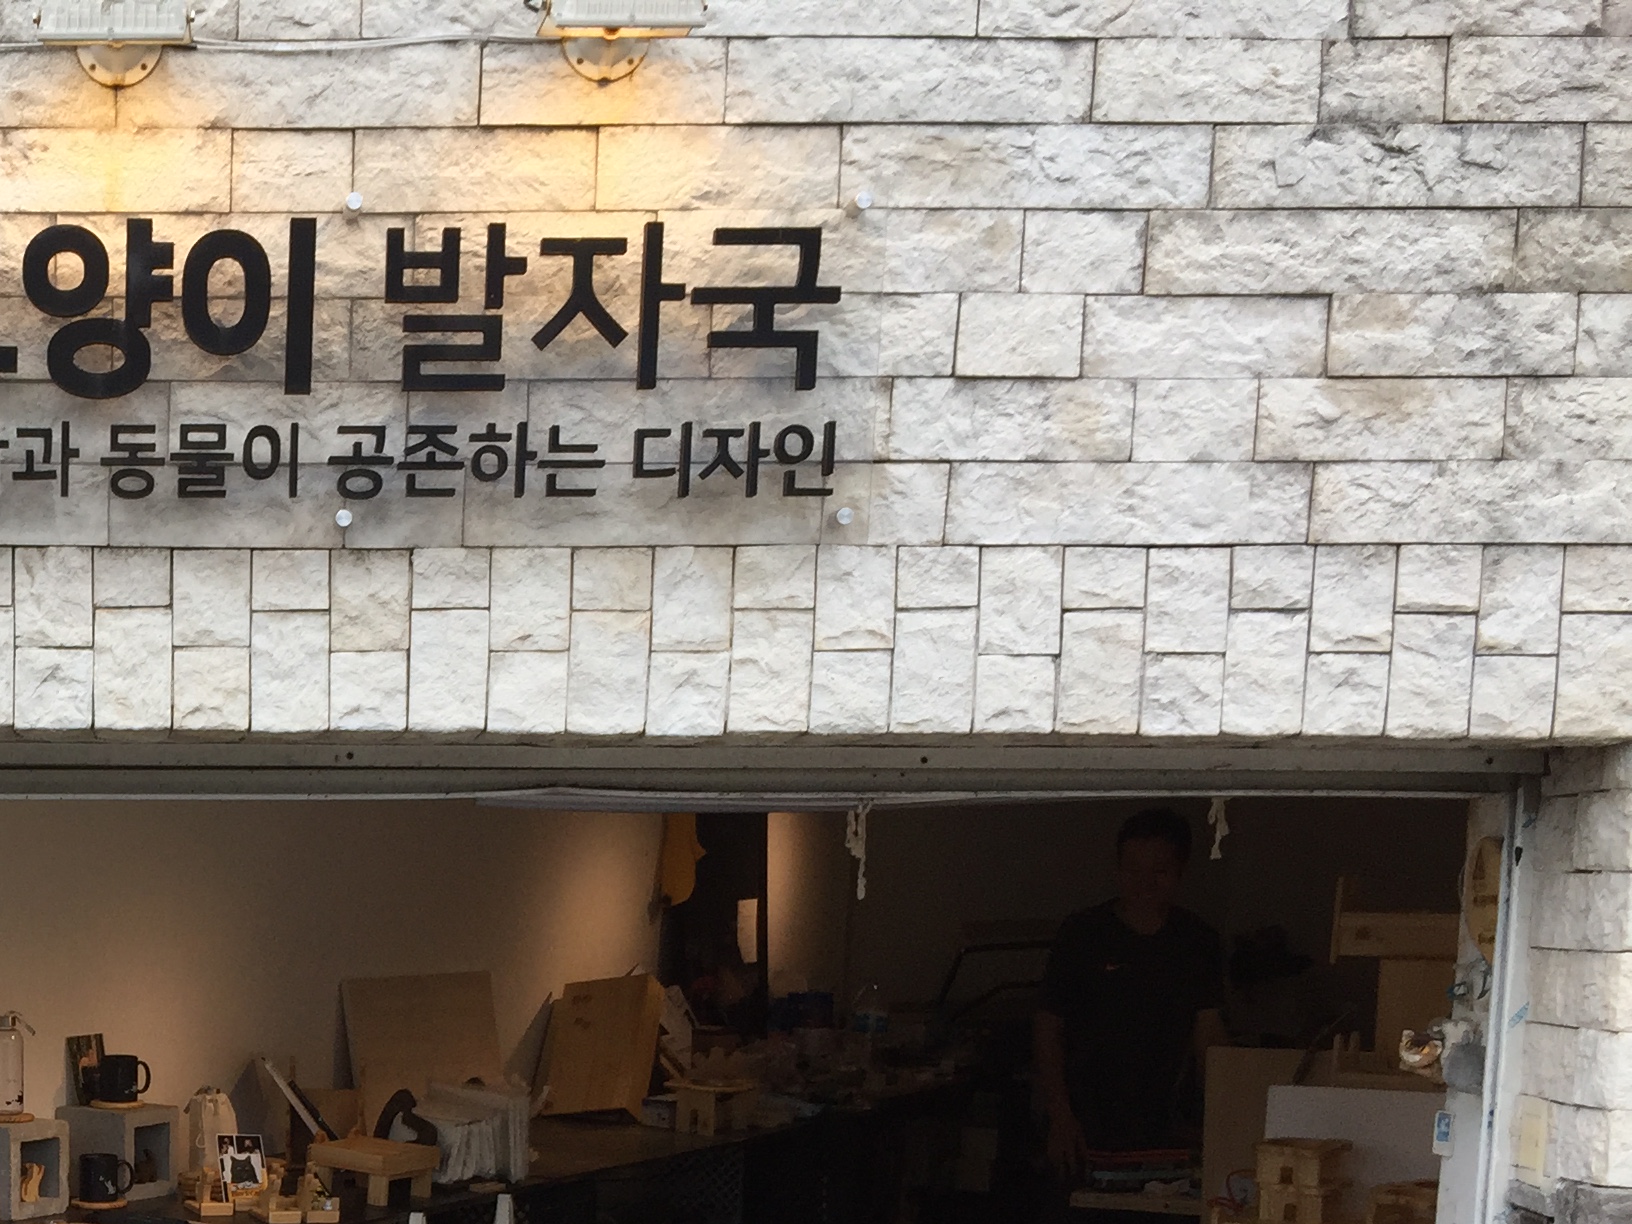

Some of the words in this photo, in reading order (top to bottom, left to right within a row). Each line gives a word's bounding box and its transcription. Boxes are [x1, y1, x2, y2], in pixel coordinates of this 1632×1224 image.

[384, 221, 841, 391] 발자국
[99, 420, 300, 499] 동물이
[326, 420, 606, 500] 공존하는
[631, 420, 837, 499] 디자인
